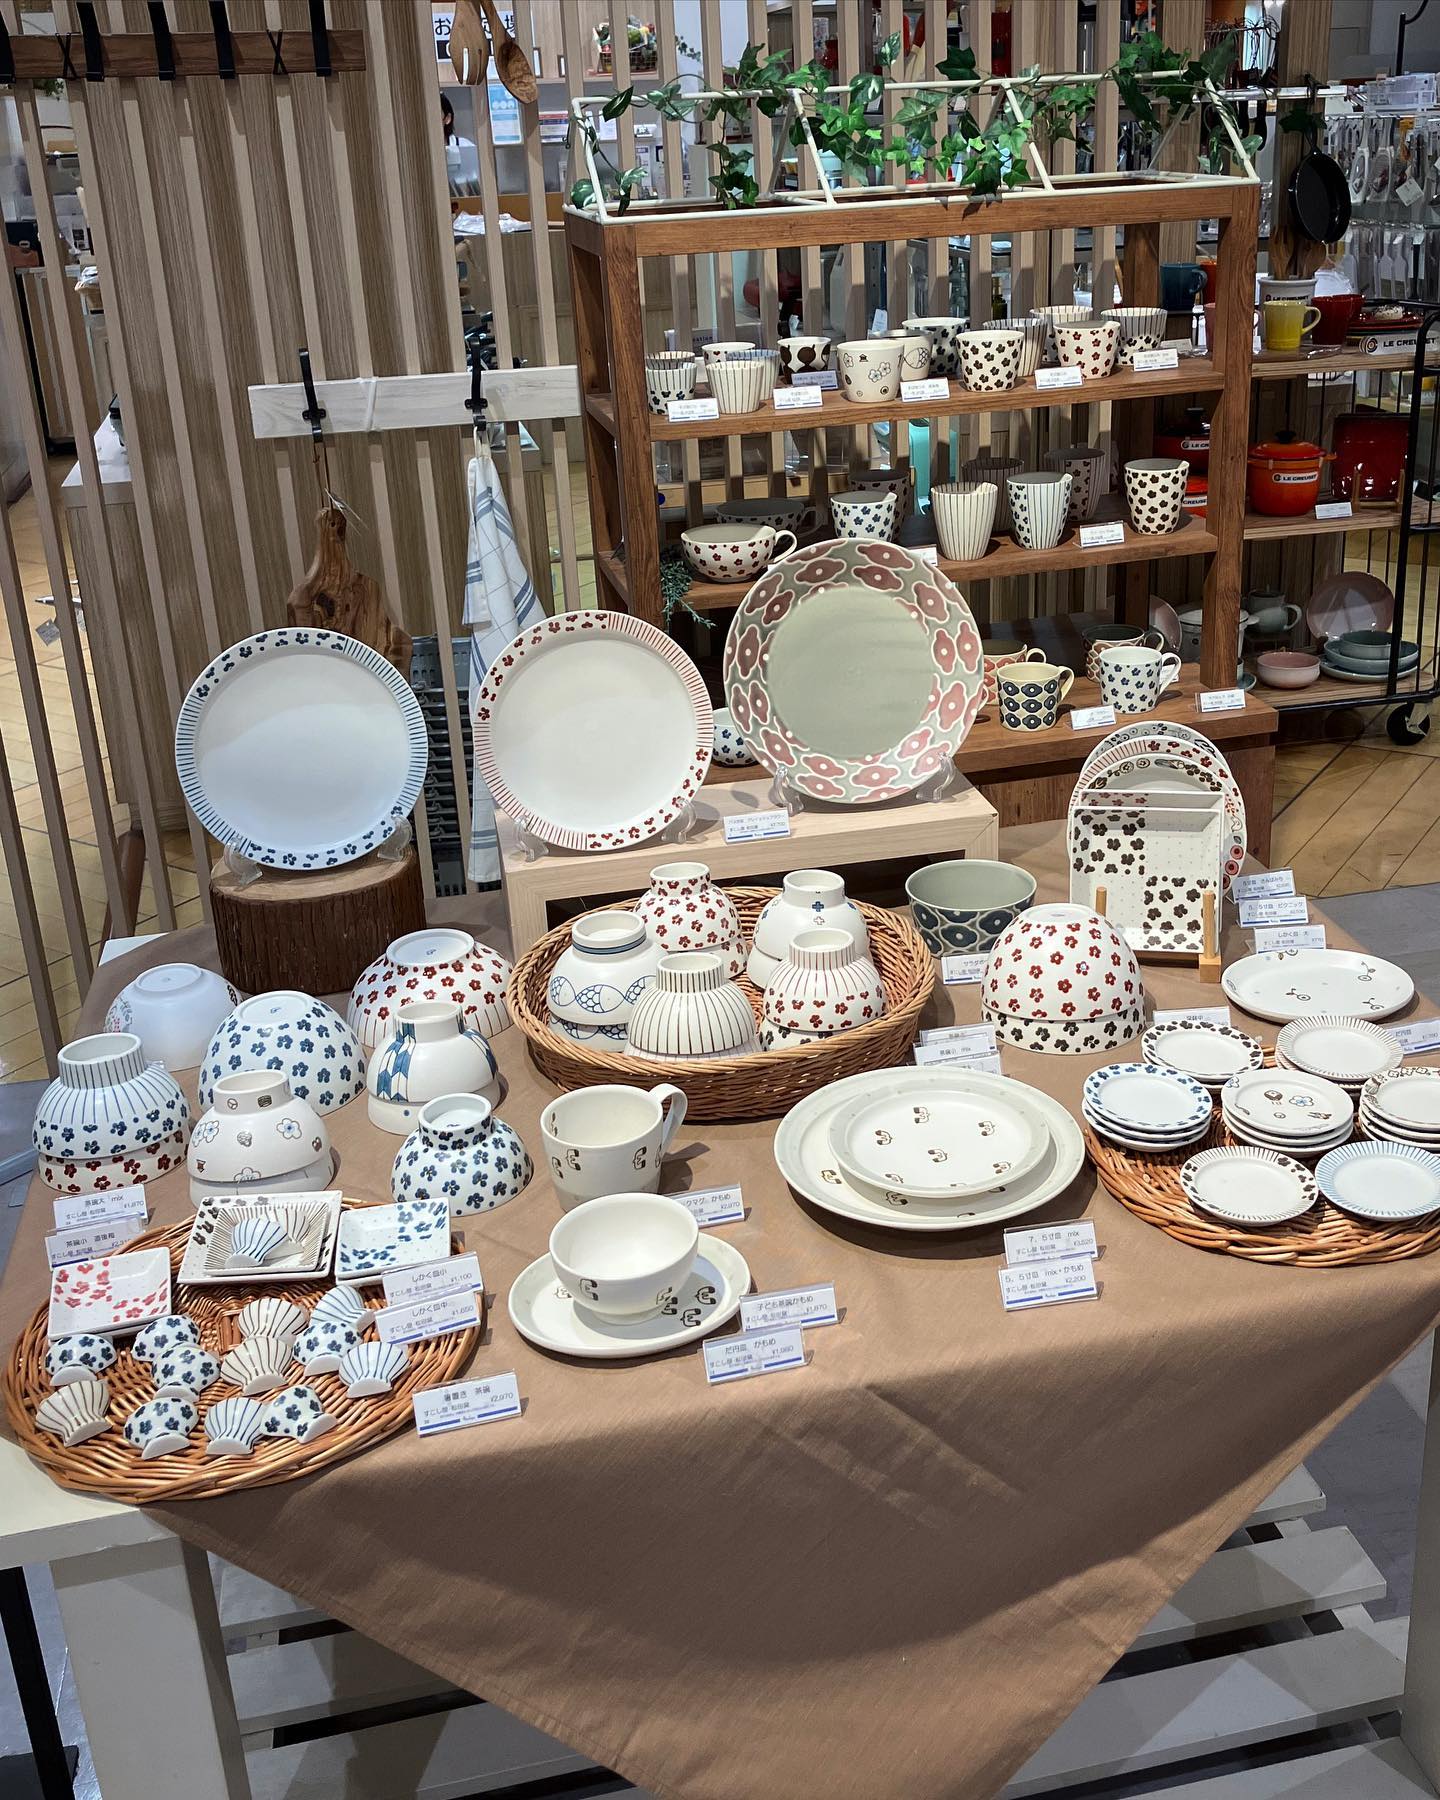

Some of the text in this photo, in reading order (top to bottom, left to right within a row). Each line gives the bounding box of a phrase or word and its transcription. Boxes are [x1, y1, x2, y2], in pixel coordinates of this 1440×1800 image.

[1396, 337, 1435, 346] CREUET
[85, 1199, 105, 1208] 茶碗大
[1067, 1230, 1080, 1238] mix
[66, 1238, 87, 1248] 茶碗小
[411, 1268, 447, 1283] しかく皿小
[451, 1272, 472, 1282] ¥1,100
[1065, 1274, 1086, 1284] ¥2,200
[412, 1301, 448, 1317] しかく皿中
[725, 1338, 776, 1355] だ円皿 かもめ
[475, 1384, 491, 1395] 茶碗
[424, 1406, 449, 1417] すこし屋
[490, 1392, 514, 1402] ¥2,970
